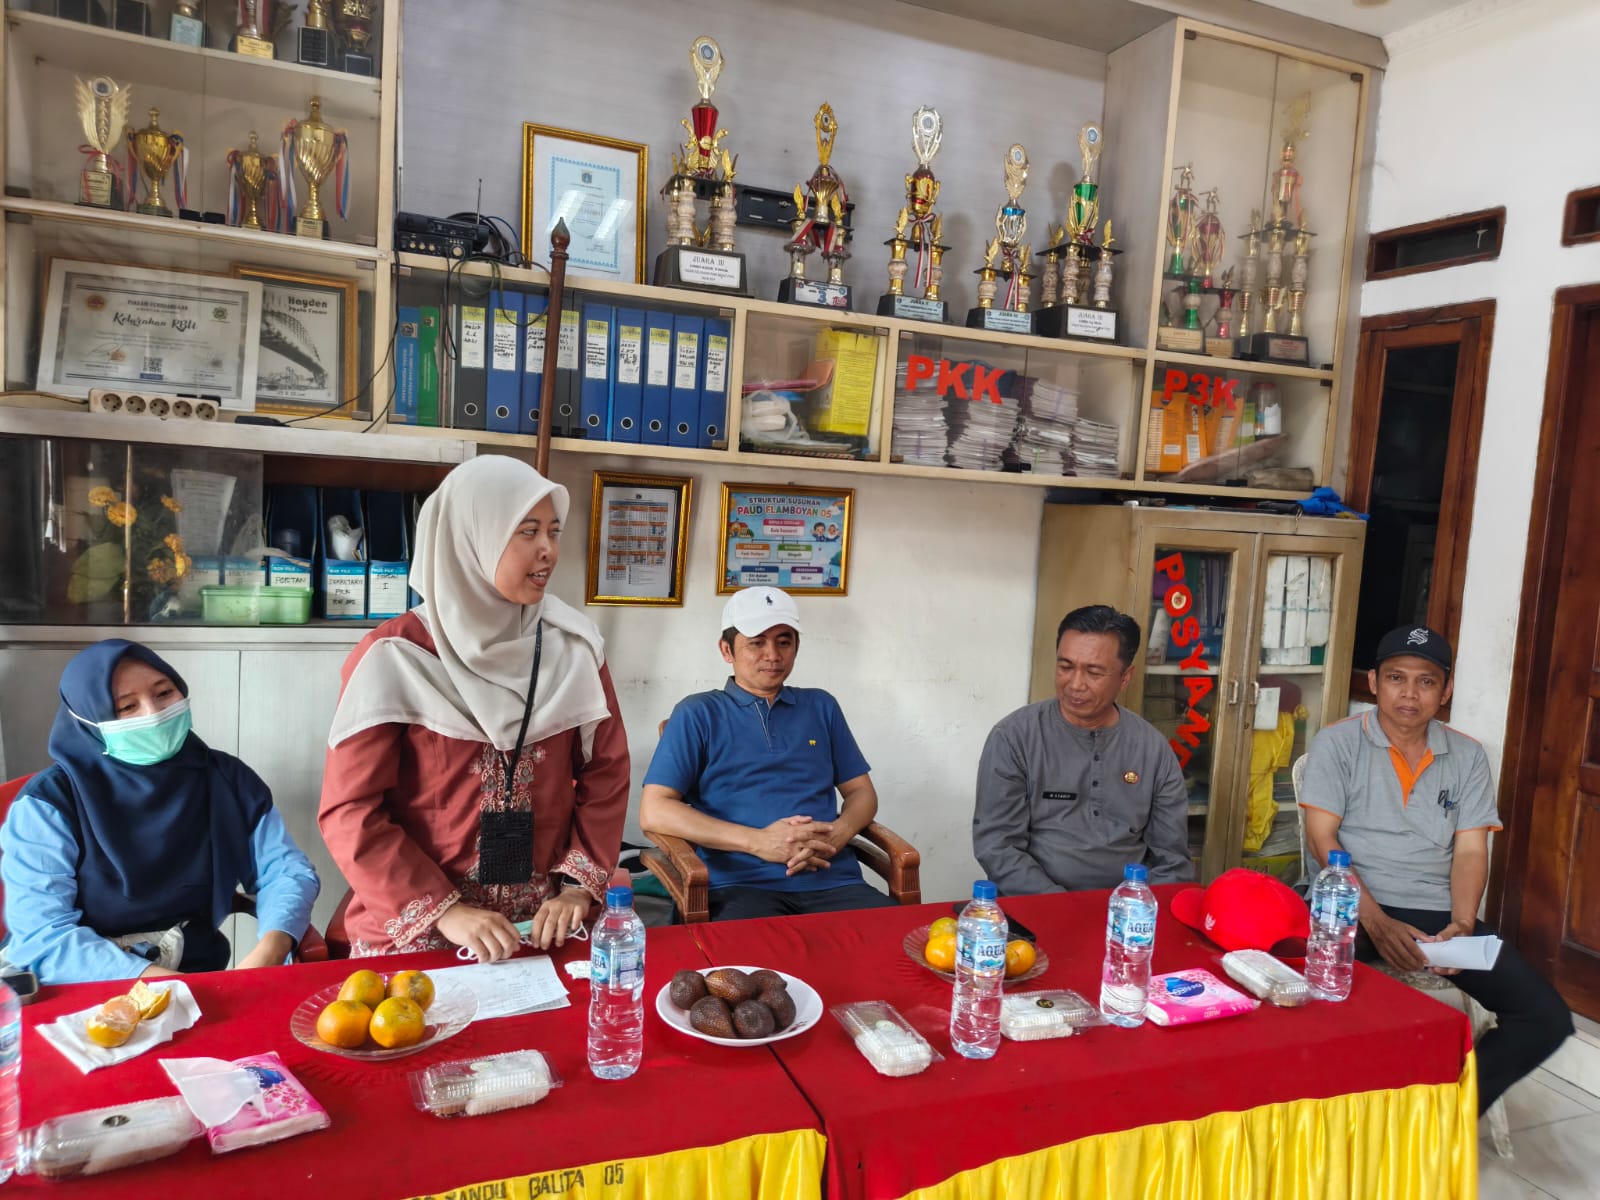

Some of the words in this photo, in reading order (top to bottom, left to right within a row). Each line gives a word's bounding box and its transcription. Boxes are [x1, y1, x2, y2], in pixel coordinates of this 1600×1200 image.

[692, 255, 715, 265] JUARA
[288, 296, 328, 308] Hayden
[905, 354, 1006, 405] PKK
[1163, 368, 1240, 411] P3K
[788, 498, 821, 506] SUSUNAN
[737, 505, 763, 516] PAUD
[765, 505, 818, 517] FLAMBOYAN
[820, 511, 832, 519] 05
[1127, 922, 1154, 936] AQUA
[977, 944, 1006, 959] AQUA
[604, 1163, 624, 1186] 05
